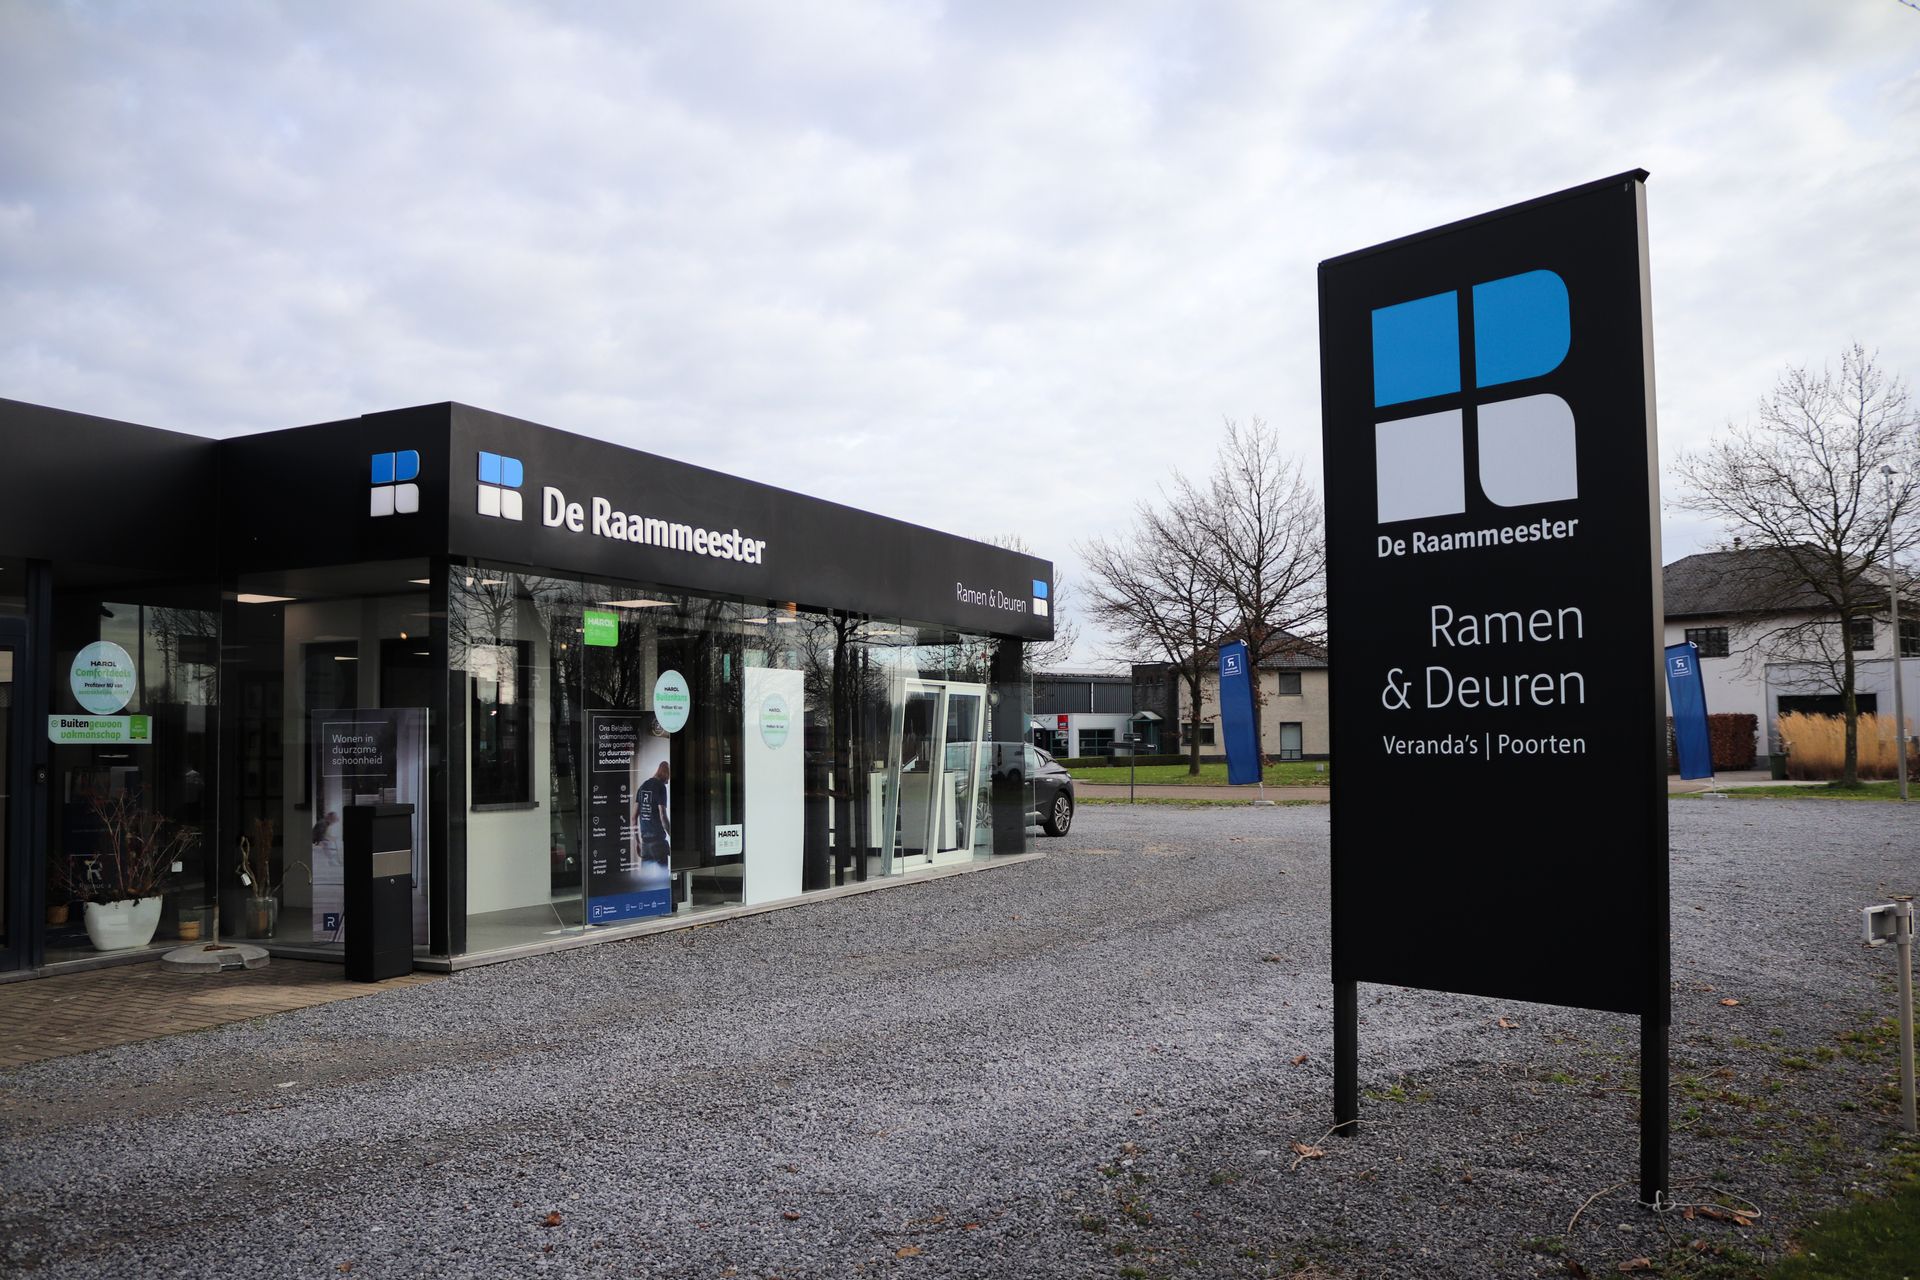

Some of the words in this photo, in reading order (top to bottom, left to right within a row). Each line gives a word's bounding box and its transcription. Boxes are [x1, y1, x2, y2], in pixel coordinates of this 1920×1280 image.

[543, 486, 584, 533] De
[592, 496, 766, 564] Raammeester
[1377, 535, 1406, 558] De
[1412, 518, 1579, 554] Raammeester
[956, 582, 987, 606] Ramen
[989, 589, 996, 608] &
[997, 590, 1027, 613] Deuren
[1431, 604, 1584, 648] Ramen
[90, 660, 117, 668] HAROL
[1381, 667, 1412, 710] &
[1426, 665, 1585, 709] Deuren
[60, 719, 122, 729] Buitengewoon
[598, 724, 610, 732] Ons
[611, 724, 633, 733] Belgisch
[61, 730, 121, 740] vakmanschap
[331, 734, 363, 743] Wonen
[365, 734, 374, 742] in
[598, 733, 638, 741] vakmanschap,
[1383, 733, 1479, 755] Veranda's
[1498, 733, 1586, 755] Poorten
[332, 745, 377, 754] duurzame
[332, 755, 383, 765] schoonheid
[598, 757, 631, 765] schoonheid
[718, 830, 740, 838] HAROL
